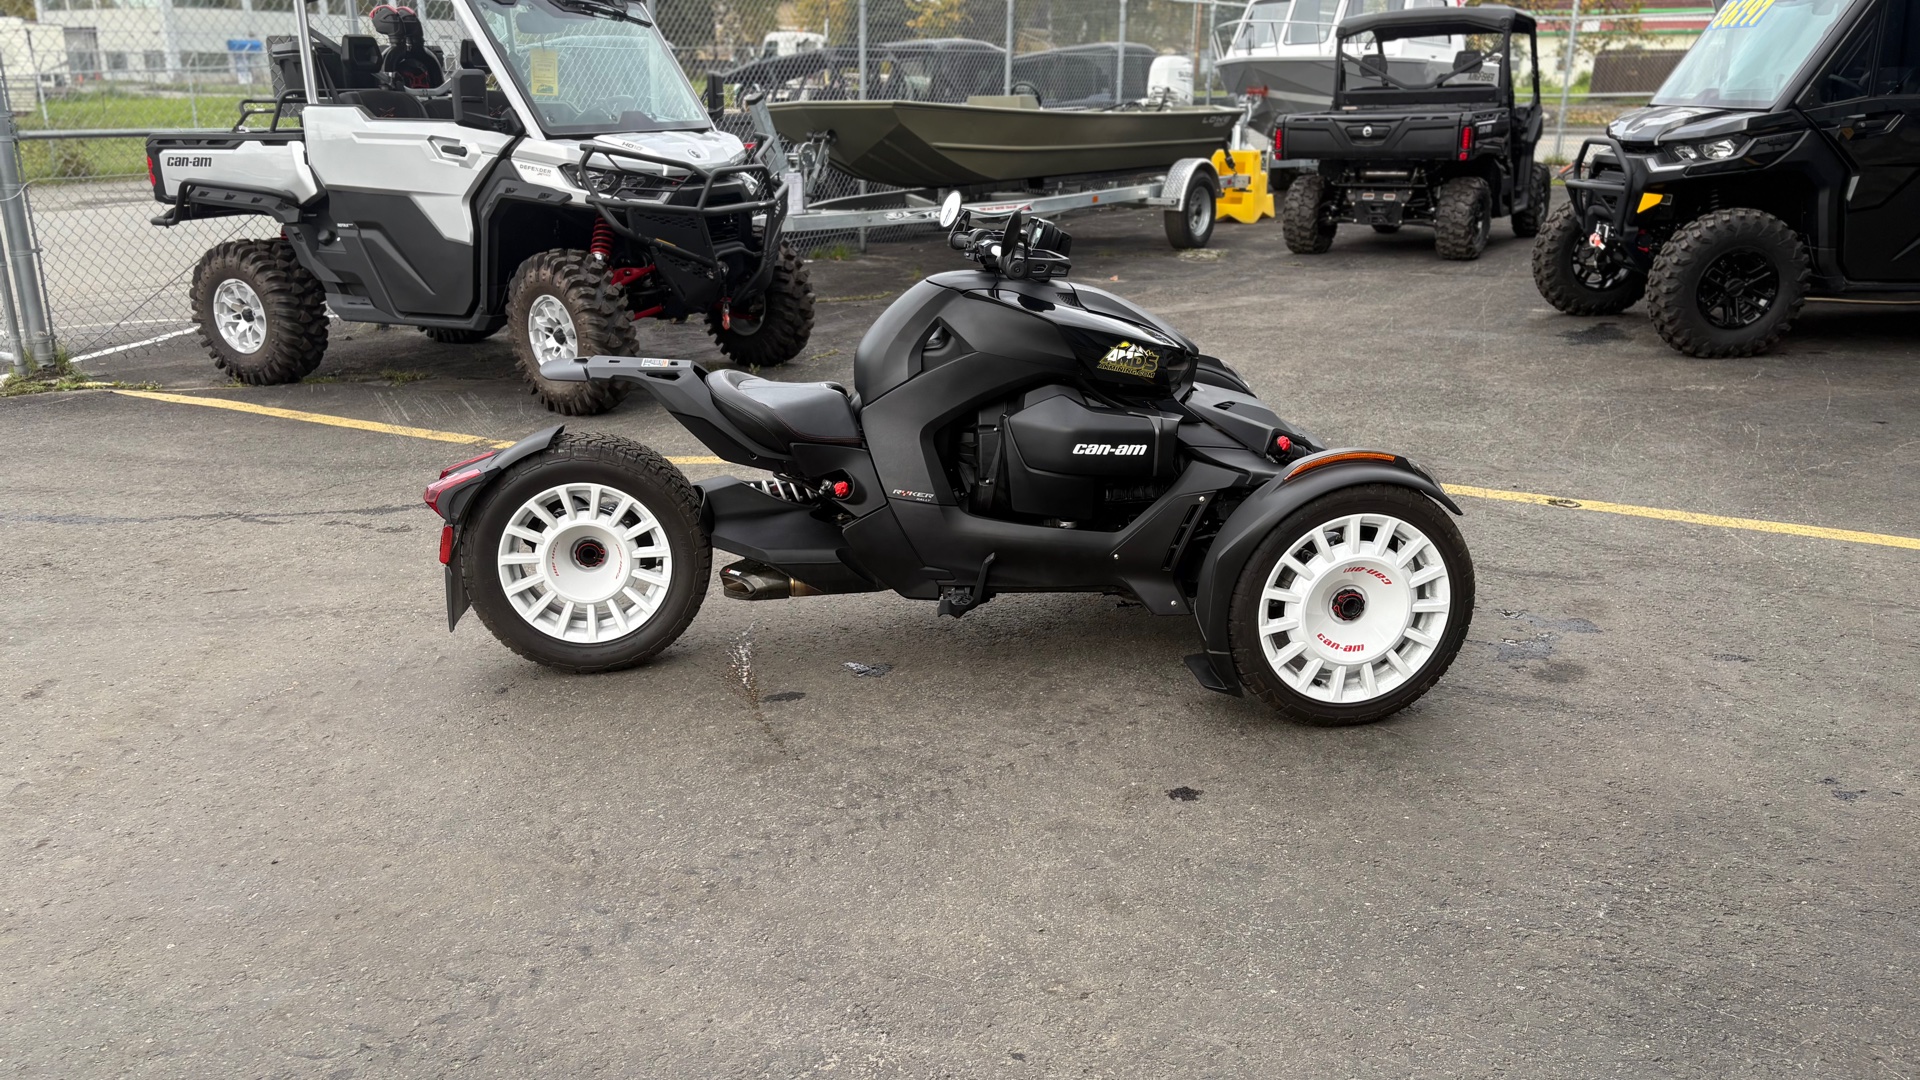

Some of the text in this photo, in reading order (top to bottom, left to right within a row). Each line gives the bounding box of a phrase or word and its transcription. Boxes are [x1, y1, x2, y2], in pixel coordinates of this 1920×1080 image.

[167, 156, 212, 167] can-am
[519, 163, 552, 174] DEFENDER
[1100, 344, 1159, 373] AMDS
[1072, 443, 1148, 456] can-am
[892, 489, 935, 498] RYKER
[1343, 566, 1393, 585] can-am
[1316, 632, 1365, 652] can-am
